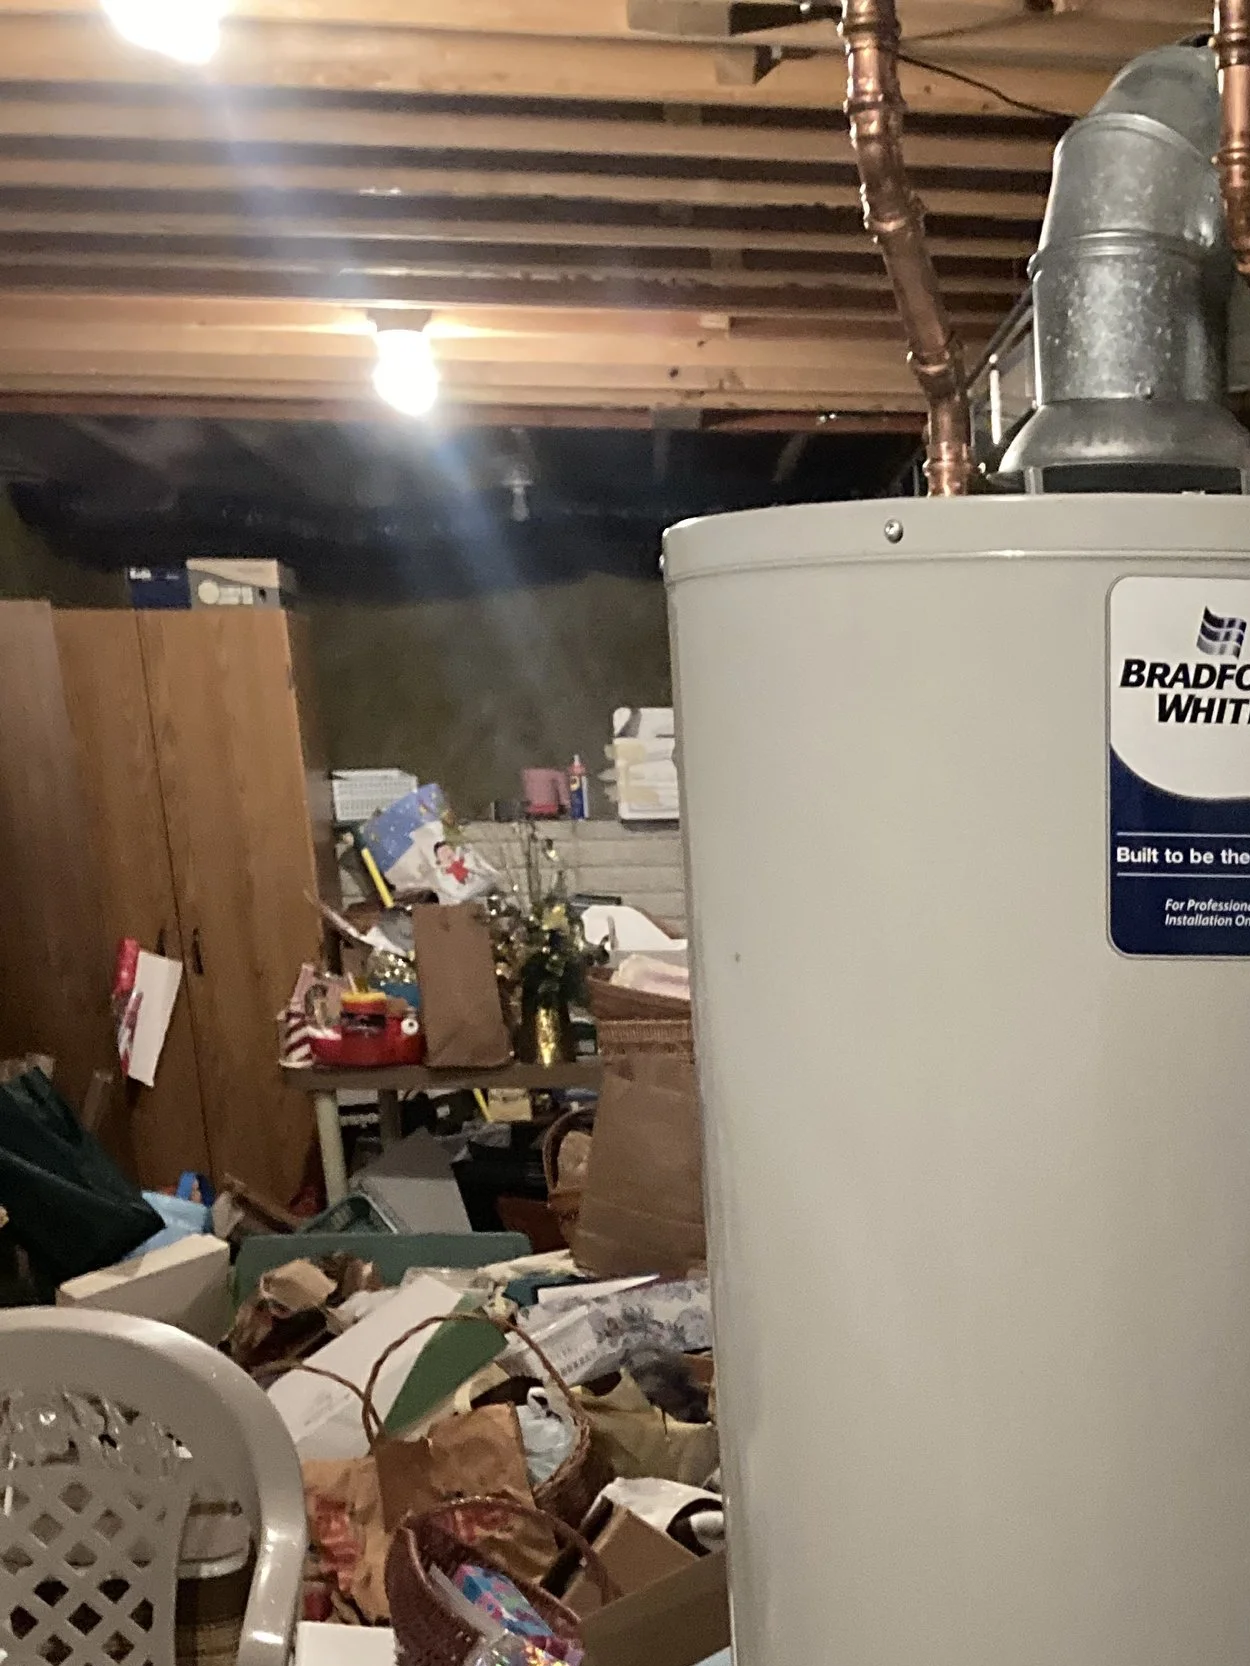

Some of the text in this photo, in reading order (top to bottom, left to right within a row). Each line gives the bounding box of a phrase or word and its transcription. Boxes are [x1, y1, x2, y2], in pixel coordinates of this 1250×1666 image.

[1116, 846, 1159, 864] Built
[1164, 849, 1184, 865] to
[1189, 848, 1214, 865] be
[1219, 848, 1250, 866] the
[1164, 898, 1185, 912] For
[1164, 913, 1234, 928] Installation
